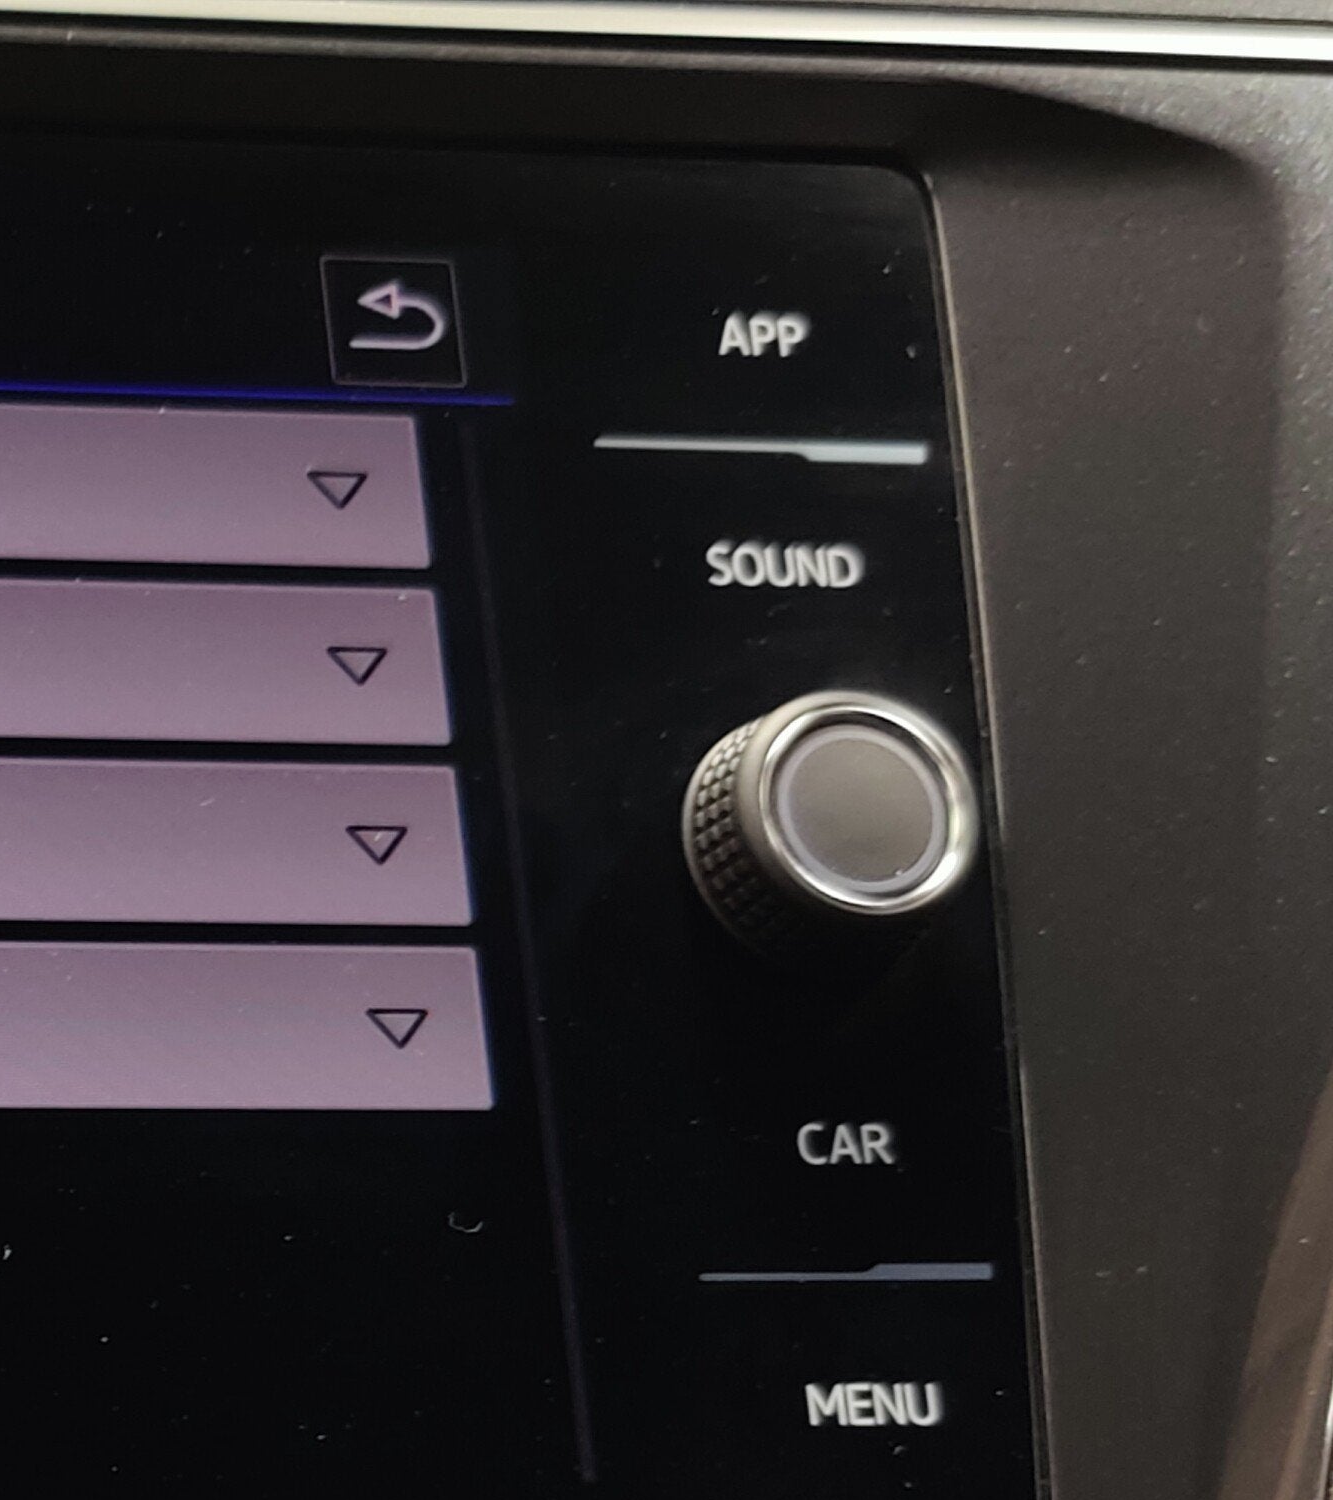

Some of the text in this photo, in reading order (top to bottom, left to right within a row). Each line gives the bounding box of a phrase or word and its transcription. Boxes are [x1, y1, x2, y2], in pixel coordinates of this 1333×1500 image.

[717, 313, 808, 359] APP
[705, 542, 862, 589] SOUND
[796, 1121, 895, 1167] CAR
[804, 1381, 941, 1428] MENU
